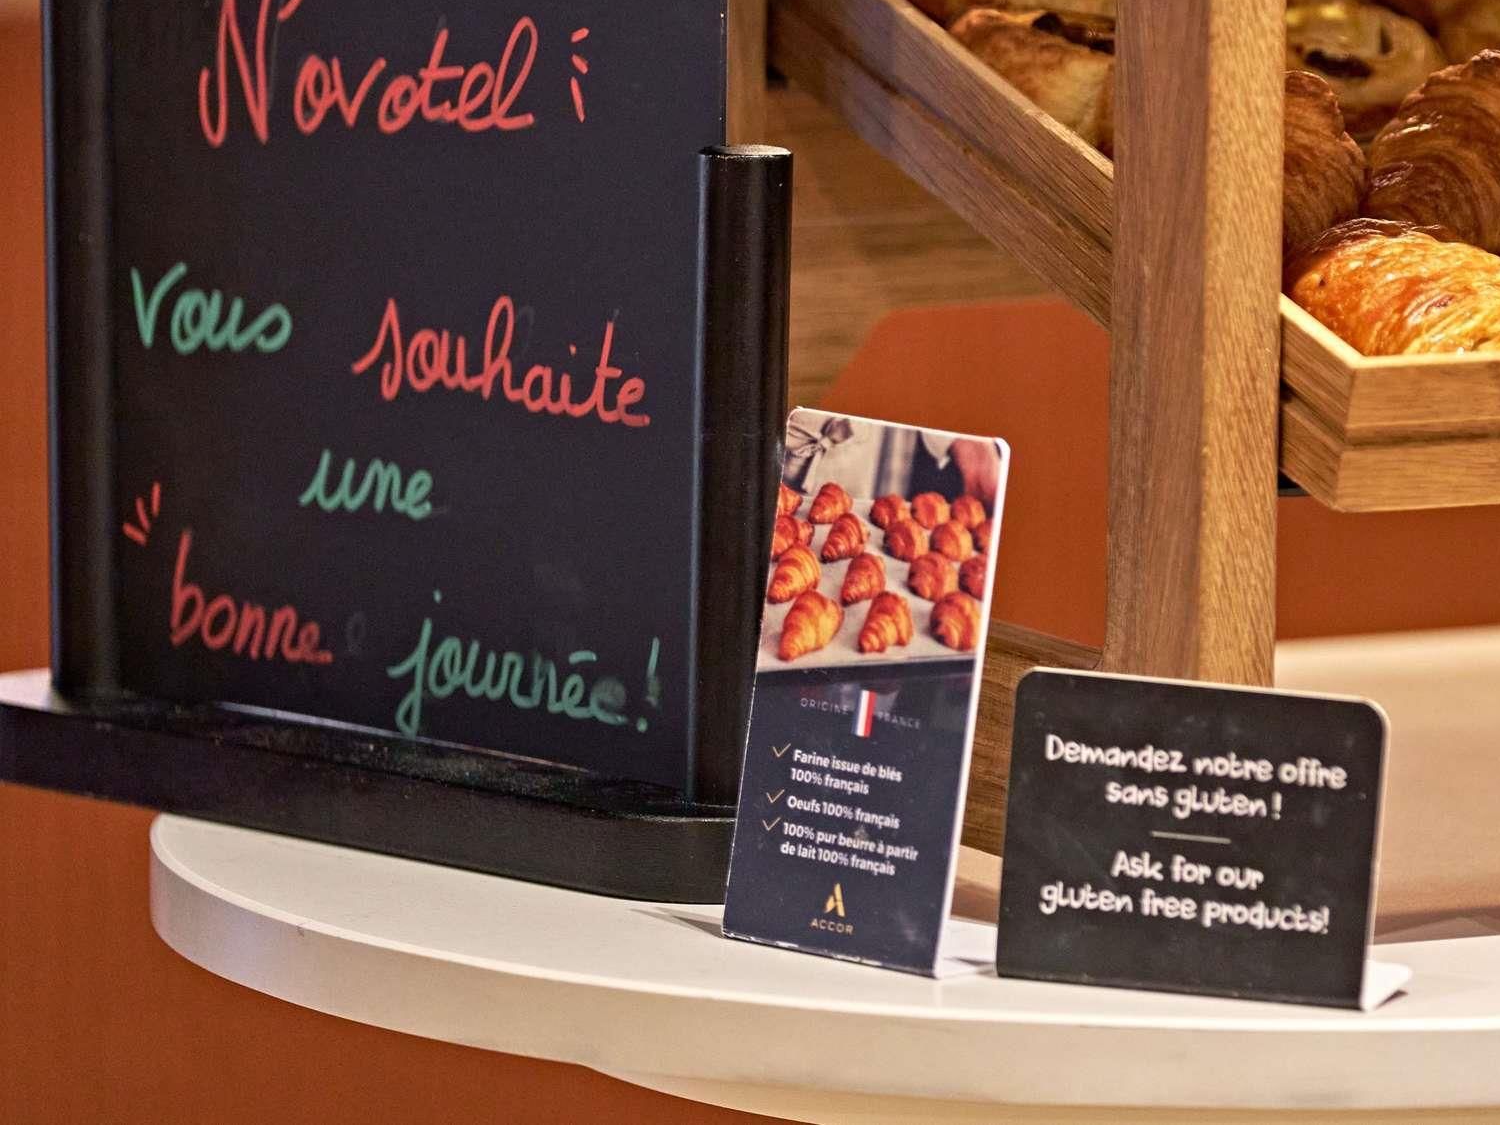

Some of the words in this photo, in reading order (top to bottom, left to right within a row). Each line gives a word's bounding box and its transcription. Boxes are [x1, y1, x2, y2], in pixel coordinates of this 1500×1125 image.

[351, 295, 651, 428] souhaite
[300, 447, 434, 521] une
[170, 528, 333, 664] bonne
[790, 767, 823, 787] 100%
[824, 773, 869, 795] français
[793, 749, 830, 768] Farine
[831, 756, 860, 774] issue
[861, 762, 877, 777] de
[879, 764, 903, 783] blés
[1044, 733, 1187, 774] Demandez
[1193, 752, 1274, 783] notre
[1277, 756, 1348, 790] offre
[787, 795, 821, 814] Oeufs
[822, 801, 854, 820] 100%
[855, 808, 900, 830] français
[1105, 781, 1170, 808] sans
[1171, 785, 1268, 819] gluten
[1271, 791, 1283, 821] !
[780, 841, 797, 856] de
[797, 844, 816, 860] lait
[817, 848, 850, 867] 100%
[850, 854, 896, 876] français
[783, 822, 815, 841] 100%
[816, 831, 838, 845] pur
[838, 832, 877, 852] beurre
[878, 838, 886, 854] à
[885, 844, 918, 862] partir
[1111, 850, 1164, 882] Ask
[1170, 854, 1212, 885] for
[1215, 865, 1264, 892] our
[810, 918, 854, 935] ACCOR
[1039, 881, 1134, 915] gluten
[1140, 887, 1197, 920] free
[1201, 900, 1331, 935] products!
